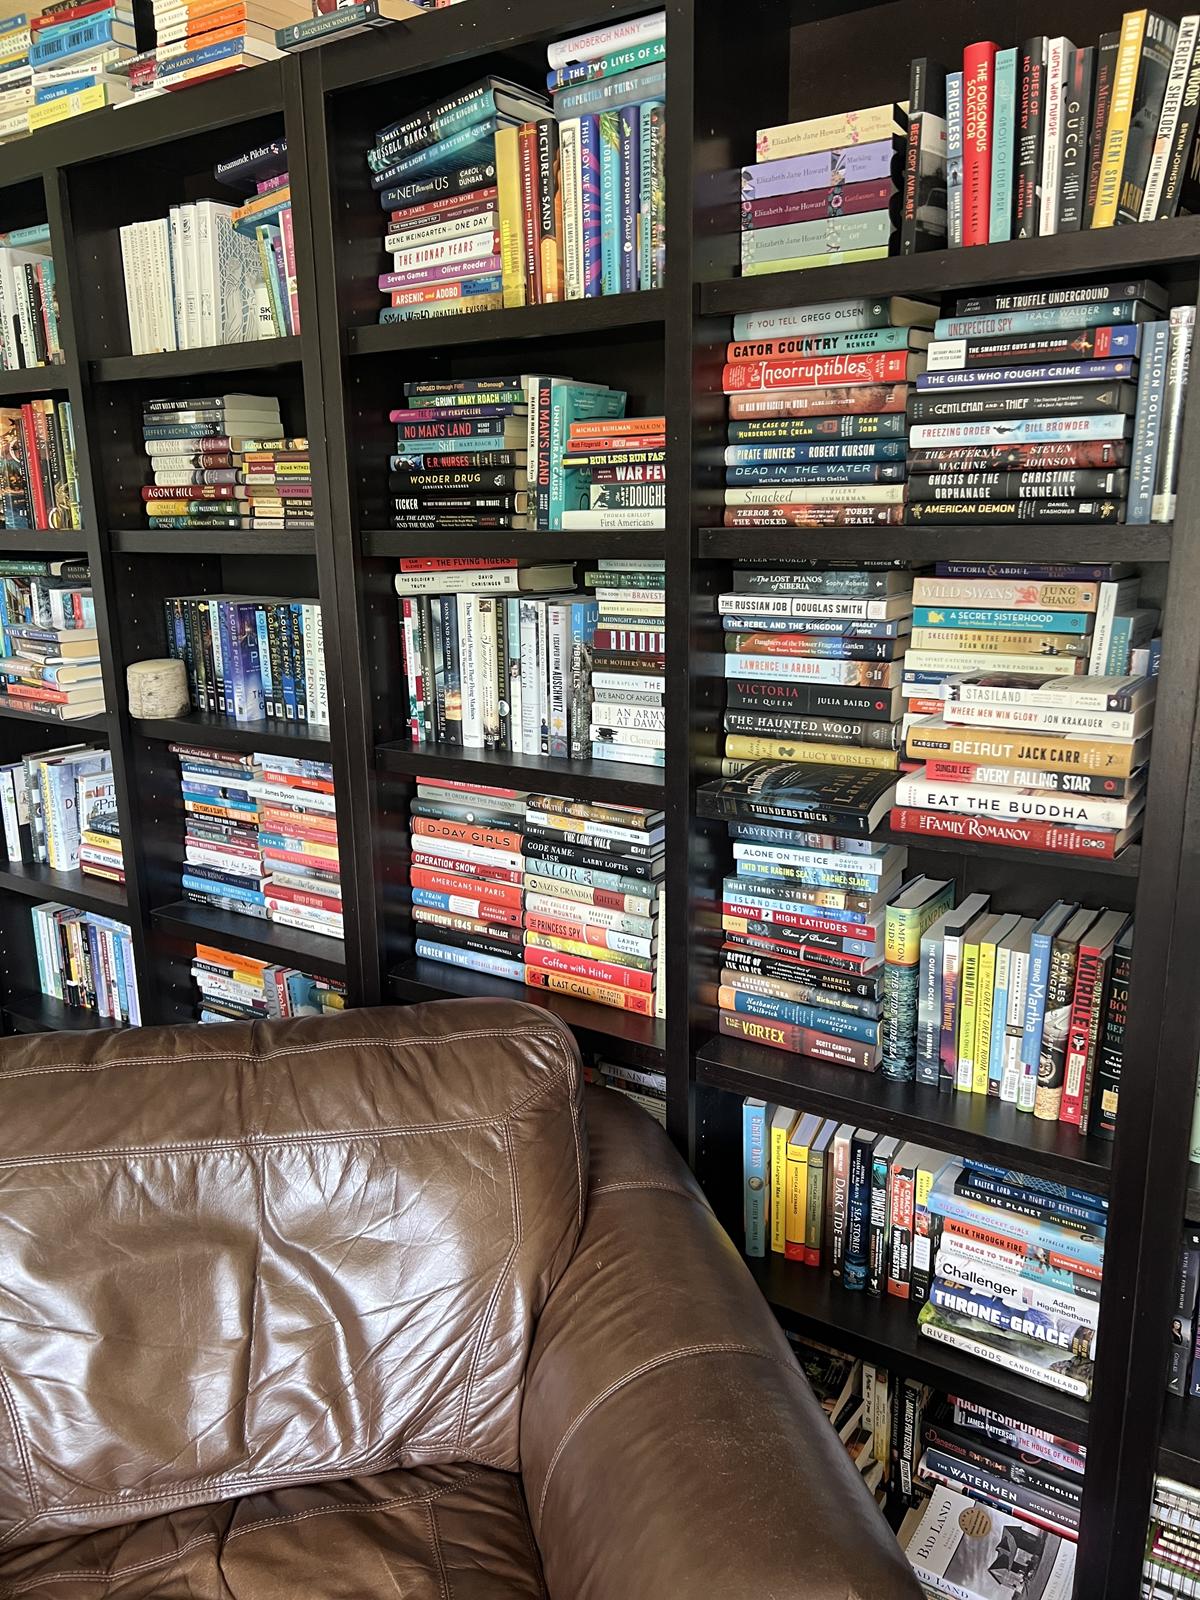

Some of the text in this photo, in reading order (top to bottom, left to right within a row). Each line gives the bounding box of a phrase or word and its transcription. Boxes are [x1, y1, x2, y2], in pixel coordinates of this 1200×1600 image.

[302, 14, 357, 36] JACQUELINE WINSPEAR
[568, 23, 641, 52] LINDBERGH NANNY
[569, 48, 650, 79] THE TWO LIVES OF
[1158, 22, 1195, 139] AMERICAN SHERLOCK
[948, 80, 959, 149] PRICELESS
[967, 80, 976, 139] SOLICITOR
[977, 62, 987, 152] THE POISONOUS
[372, 126, 428, 162] RUSSELL BANKS
[1064, 101, 1080, 167] GUCCI
[217, 146, 269, 173] Rosamunde Pilcher
[539, 125, 549, 177] PICTURE
[583, 176, 590, 189] WE
[543, 196, 551, 230] SAND
[754, 200, 825, 217] Elizabeth Jane Howard
[455, 217, 488, 230] ONE DAY
[399, 241, 473, 266] THE KIDNAP YEARS
[388, 271, 428, 283] Seven Games
[996, 287, 1109, 309] THE TRUFFLE UNDERGROUND
[801, 308, 864, 323] GREGG OLSEN
[734, 337, 839, 358] GATOR COUNTRY
[760, 356, 866, 389] Incorruptibles
[927, 366, 1081, 384] THE GIRLS WHO FOUGHT CRIME
[1140, 332, 1165, 499] BILLION DOLLAR WHALE
[404, 422, 471, 438] NO MAN'S LAND
[922, 420, 1089, 438] FREEZING ORDER BILL BROWDER
[737, 444, 875, 460] PIRATE HUNTERS ROBERT KURSON
[410, 473, 481, 485] WONDER DRUG
[736, 464, 870, 475] DEAD IN THE WATER
[148, 487, 193, 498] AGONY HILL
[744, 491, 792, 503] Smacked
[924, 504, 1015, 514] AMERICAN DEMON
[722, 601, 862, 614] THE RUSSIAN JOB DOUGLAS SMITH
[571, 630, 582, 689] LUMBERJILLS
[552, 669, 563, 713] AUSCHWITZ
[736, 683, 798, 698] VICTORIA
[817, 697, 870, 708] JULIA BAIRD
[966, 688, 1021, 702] STASILAND
[729, 715, 862, 735] THE HAUNTED WOOD
[1043, 714, 1102, 728] JON KRAKAUER
[952, 740, 1080, 764] BEIRUT JACK CARR
[976, 767, 1091, 792] EVERY FALLING STAR
[750, 805, 828, 822] THUNDERSTRUCK
[928, 793, 1089, 820] EAT THE BUDDHA
[427, 825, 510, 847] D-DAY GIRLS
[926, 816, 1030, 841] FAMILY ROMANOV
[528, 842, 574, 857] CODE NAME:
[743, 849, 828, 865] ALONE ON THE ICE
[534, 860, 578, 880] VALOR
[537, 922, 580, 938] PRINCESS SPY
[730, 906, 848, 933] MOWAT HIGH LATITUDES
[542, 957, 612, 980] Coffee with Hitler
[1049, 951, 1060, 1000] SPENCER
[1057, 953, 1069, 1003] CHARLES
[552, 978, 591, 996] LAST CALL
[1074, 953, 1098, 1030] MURDLE
[277, 984, 286, 1016] Books
[1026, 984, 1045, 1033] Martha
[742, 1020, 785, 1044] VORTEX
[834, 1178, 845, 1235] DARK TIDE
[961, 1189, 1042, 1218] INTO THE PLANET
[892, 1231, 900, 1278] WINCHESTER
[942, 1262, 1018, 1298] Challenger
[1036, 1300, 1092, 1325] Higginbotham
[1053, 1298, 1076, 1312] Adam
[935, 1289, 1070, 1349] THRONE GRACE
[927, 1328, 1079, 1391] RIVER GODS CANDICE MILLARD
[937, 1463, 1017, 1502] THE WATERMEN
[917, 1500, 952, 1559] BAD LAND
